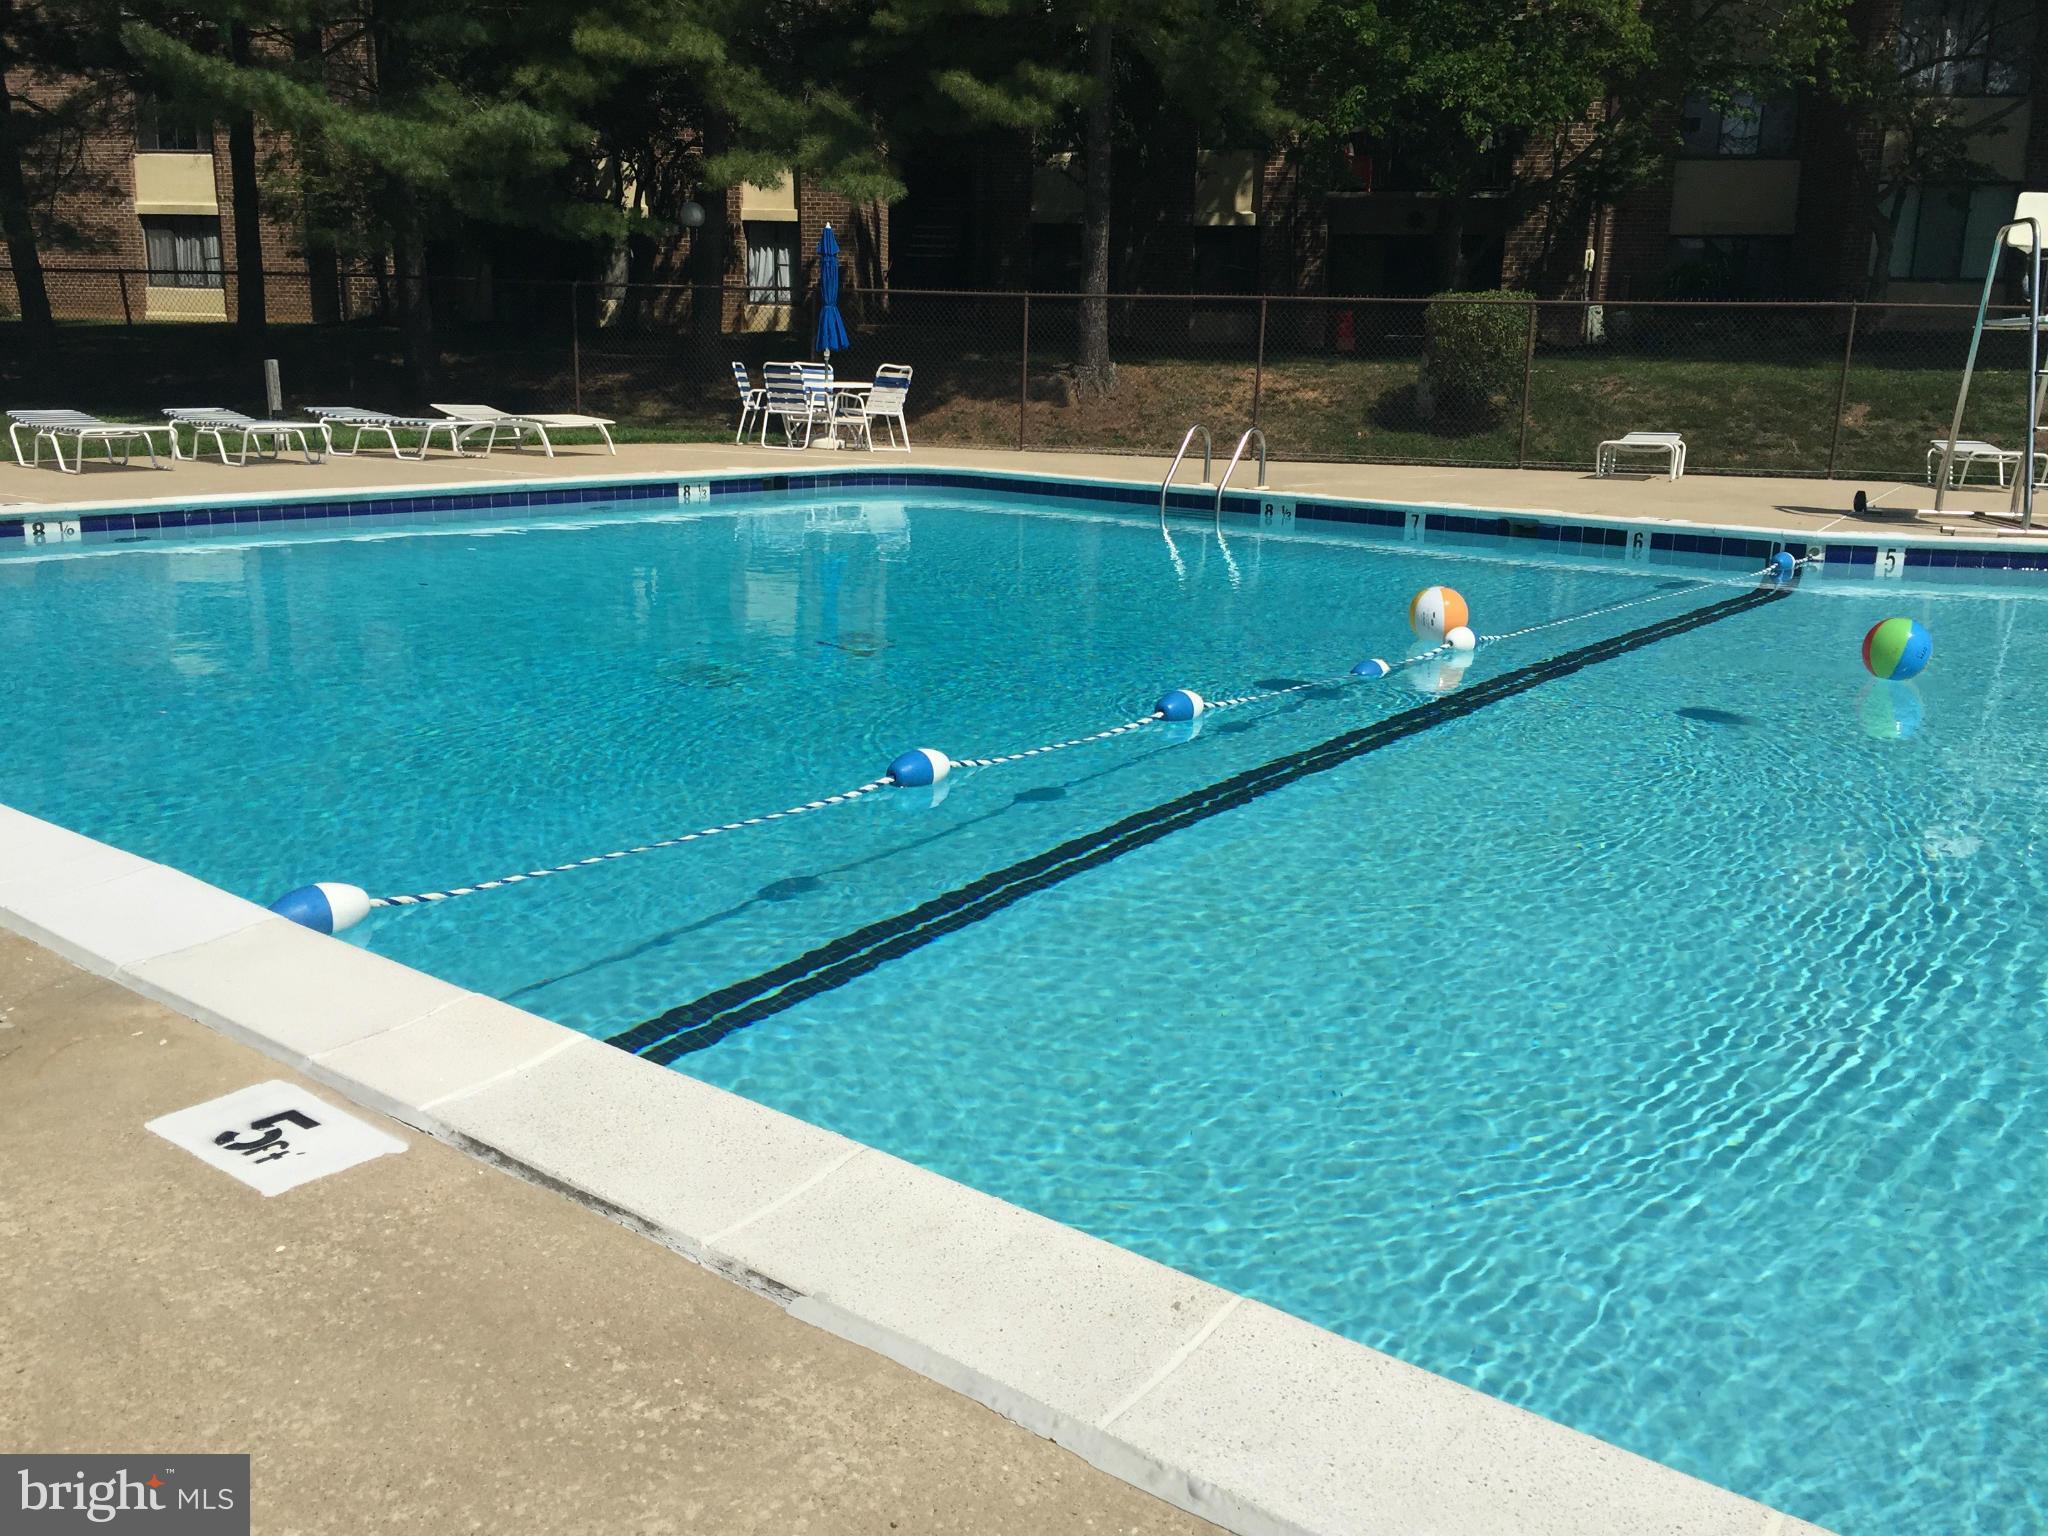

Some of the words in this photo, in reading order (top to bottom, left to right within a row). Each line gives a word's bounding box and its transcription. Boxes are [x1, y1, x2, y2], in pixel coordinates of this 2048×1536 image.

[683, 484, 691, 498] 8
[1264, 503, 1274, 518] 8
[1411, 514, 1420, 529] 7
[32, 522, 46, 539] 8
[1633, 532, 1644, 549] 6
[1885, 548, 1897, 571] 5
